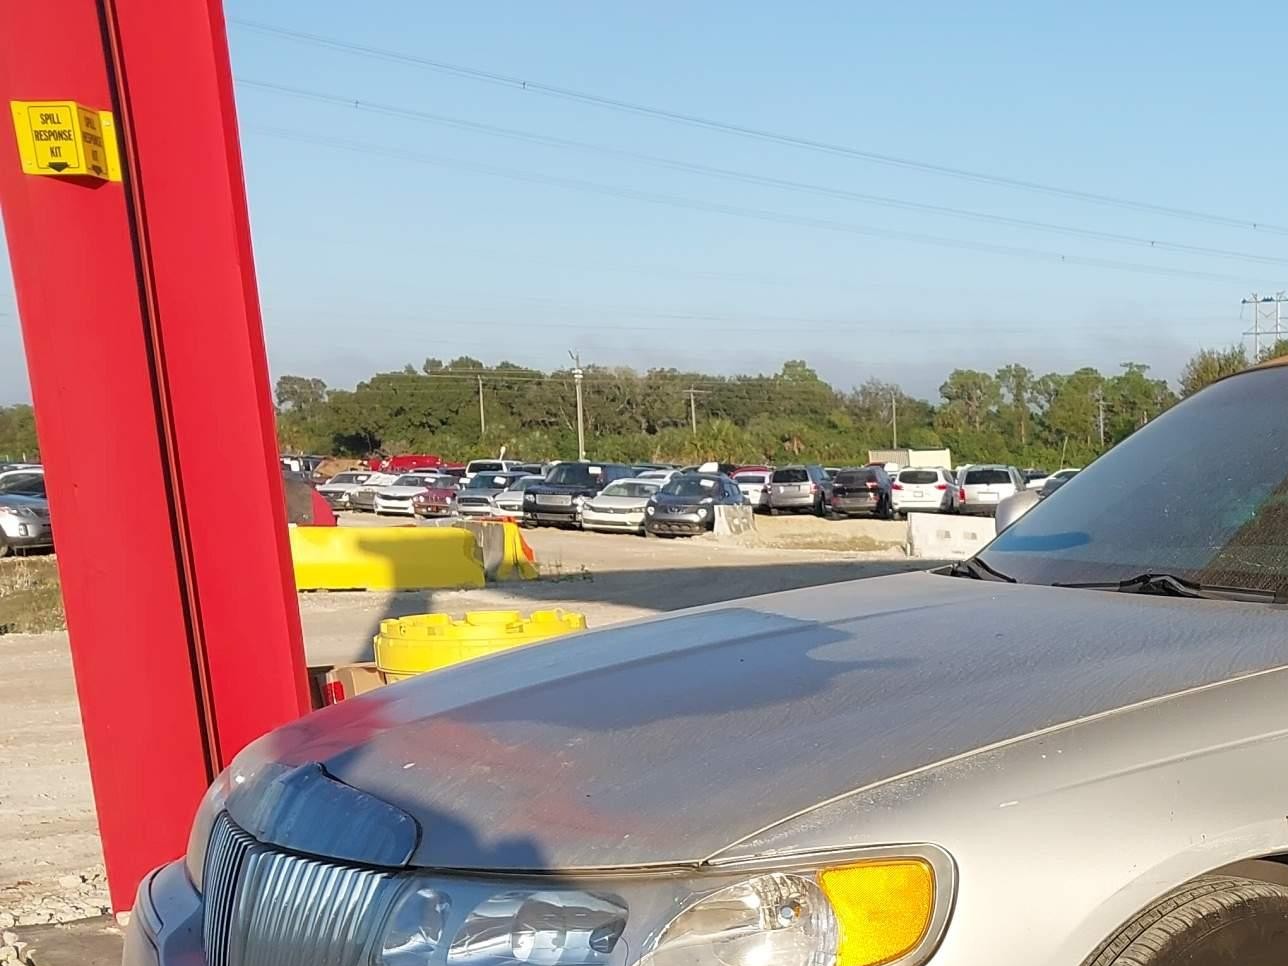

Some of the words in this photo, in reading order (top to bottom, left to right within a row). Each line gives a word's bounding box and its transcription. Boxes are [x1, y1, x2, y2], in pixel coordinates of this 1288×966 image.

[40, 113, 62, 125] SPILL
[33, 129, 73, 142] RESPONSE
[49, 146, 62, 158] KIT
